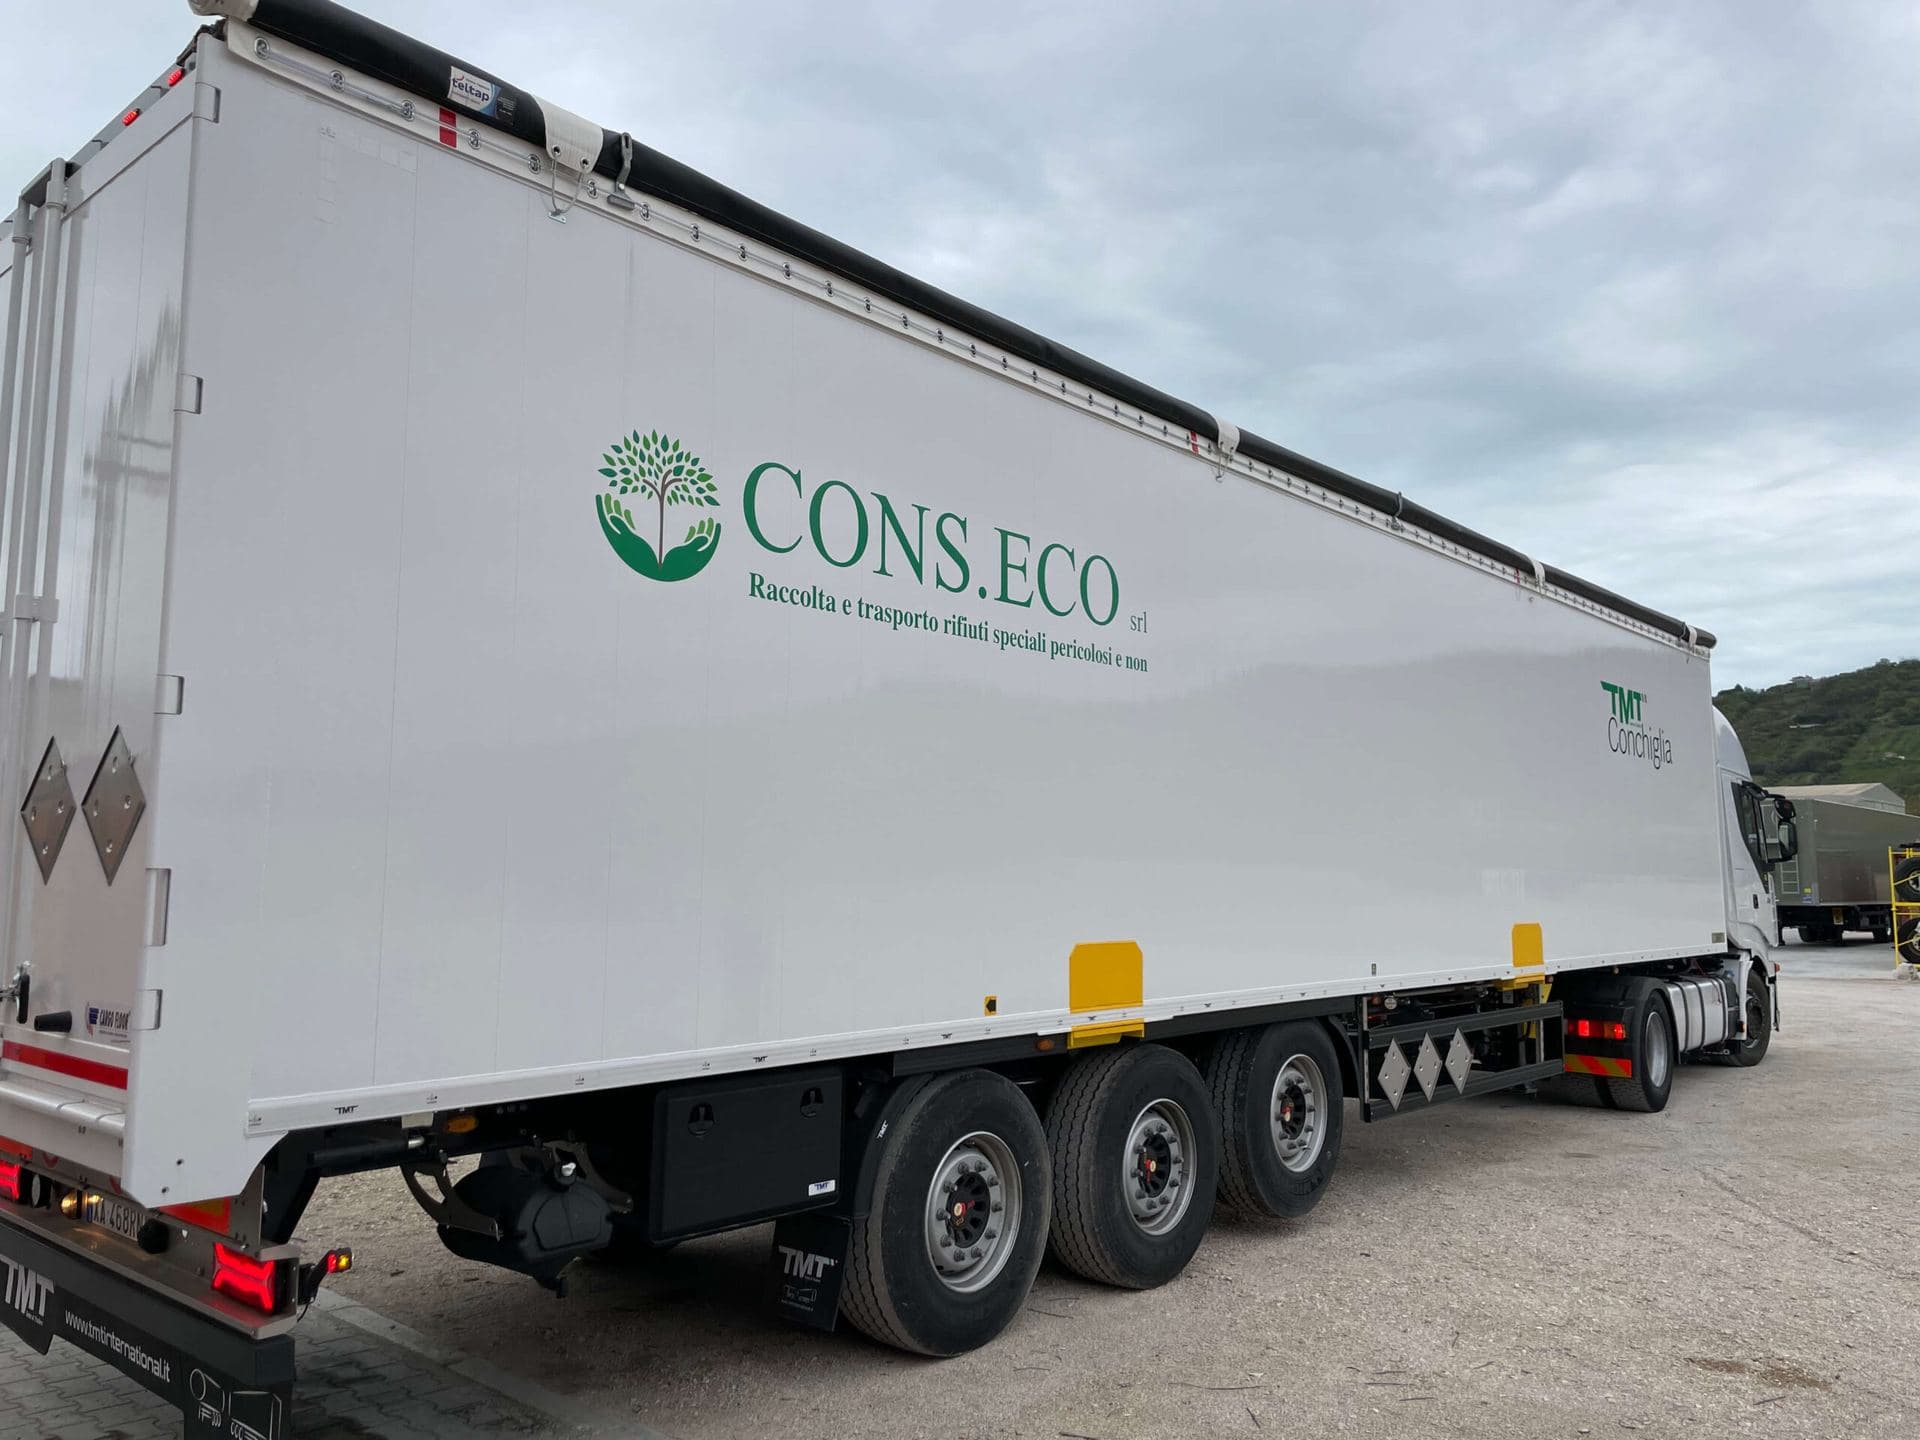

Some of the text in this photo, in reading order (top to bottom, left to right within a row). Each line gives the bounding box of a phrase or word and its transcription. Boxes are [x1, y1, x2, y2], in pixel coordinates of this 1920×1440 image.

[452, 78, 490, 102] teltap
[742, 462, 1148, 633] CONS.ECO srl
[749, 572, 1148, 673] Raccolta e trasporto rifiuti speciali pericolosi e non
[1600, 680, 1642, 725] TMT
[1608, 716, 1673, 770] Conchiglia
[334, 1105, 359, 1115] TMT
[0, 1254, 55, 1318] TMT
[779, 1245, 830, 1279] TMT
[65, 1309, 170, 1383] www.tmtinternational.it
